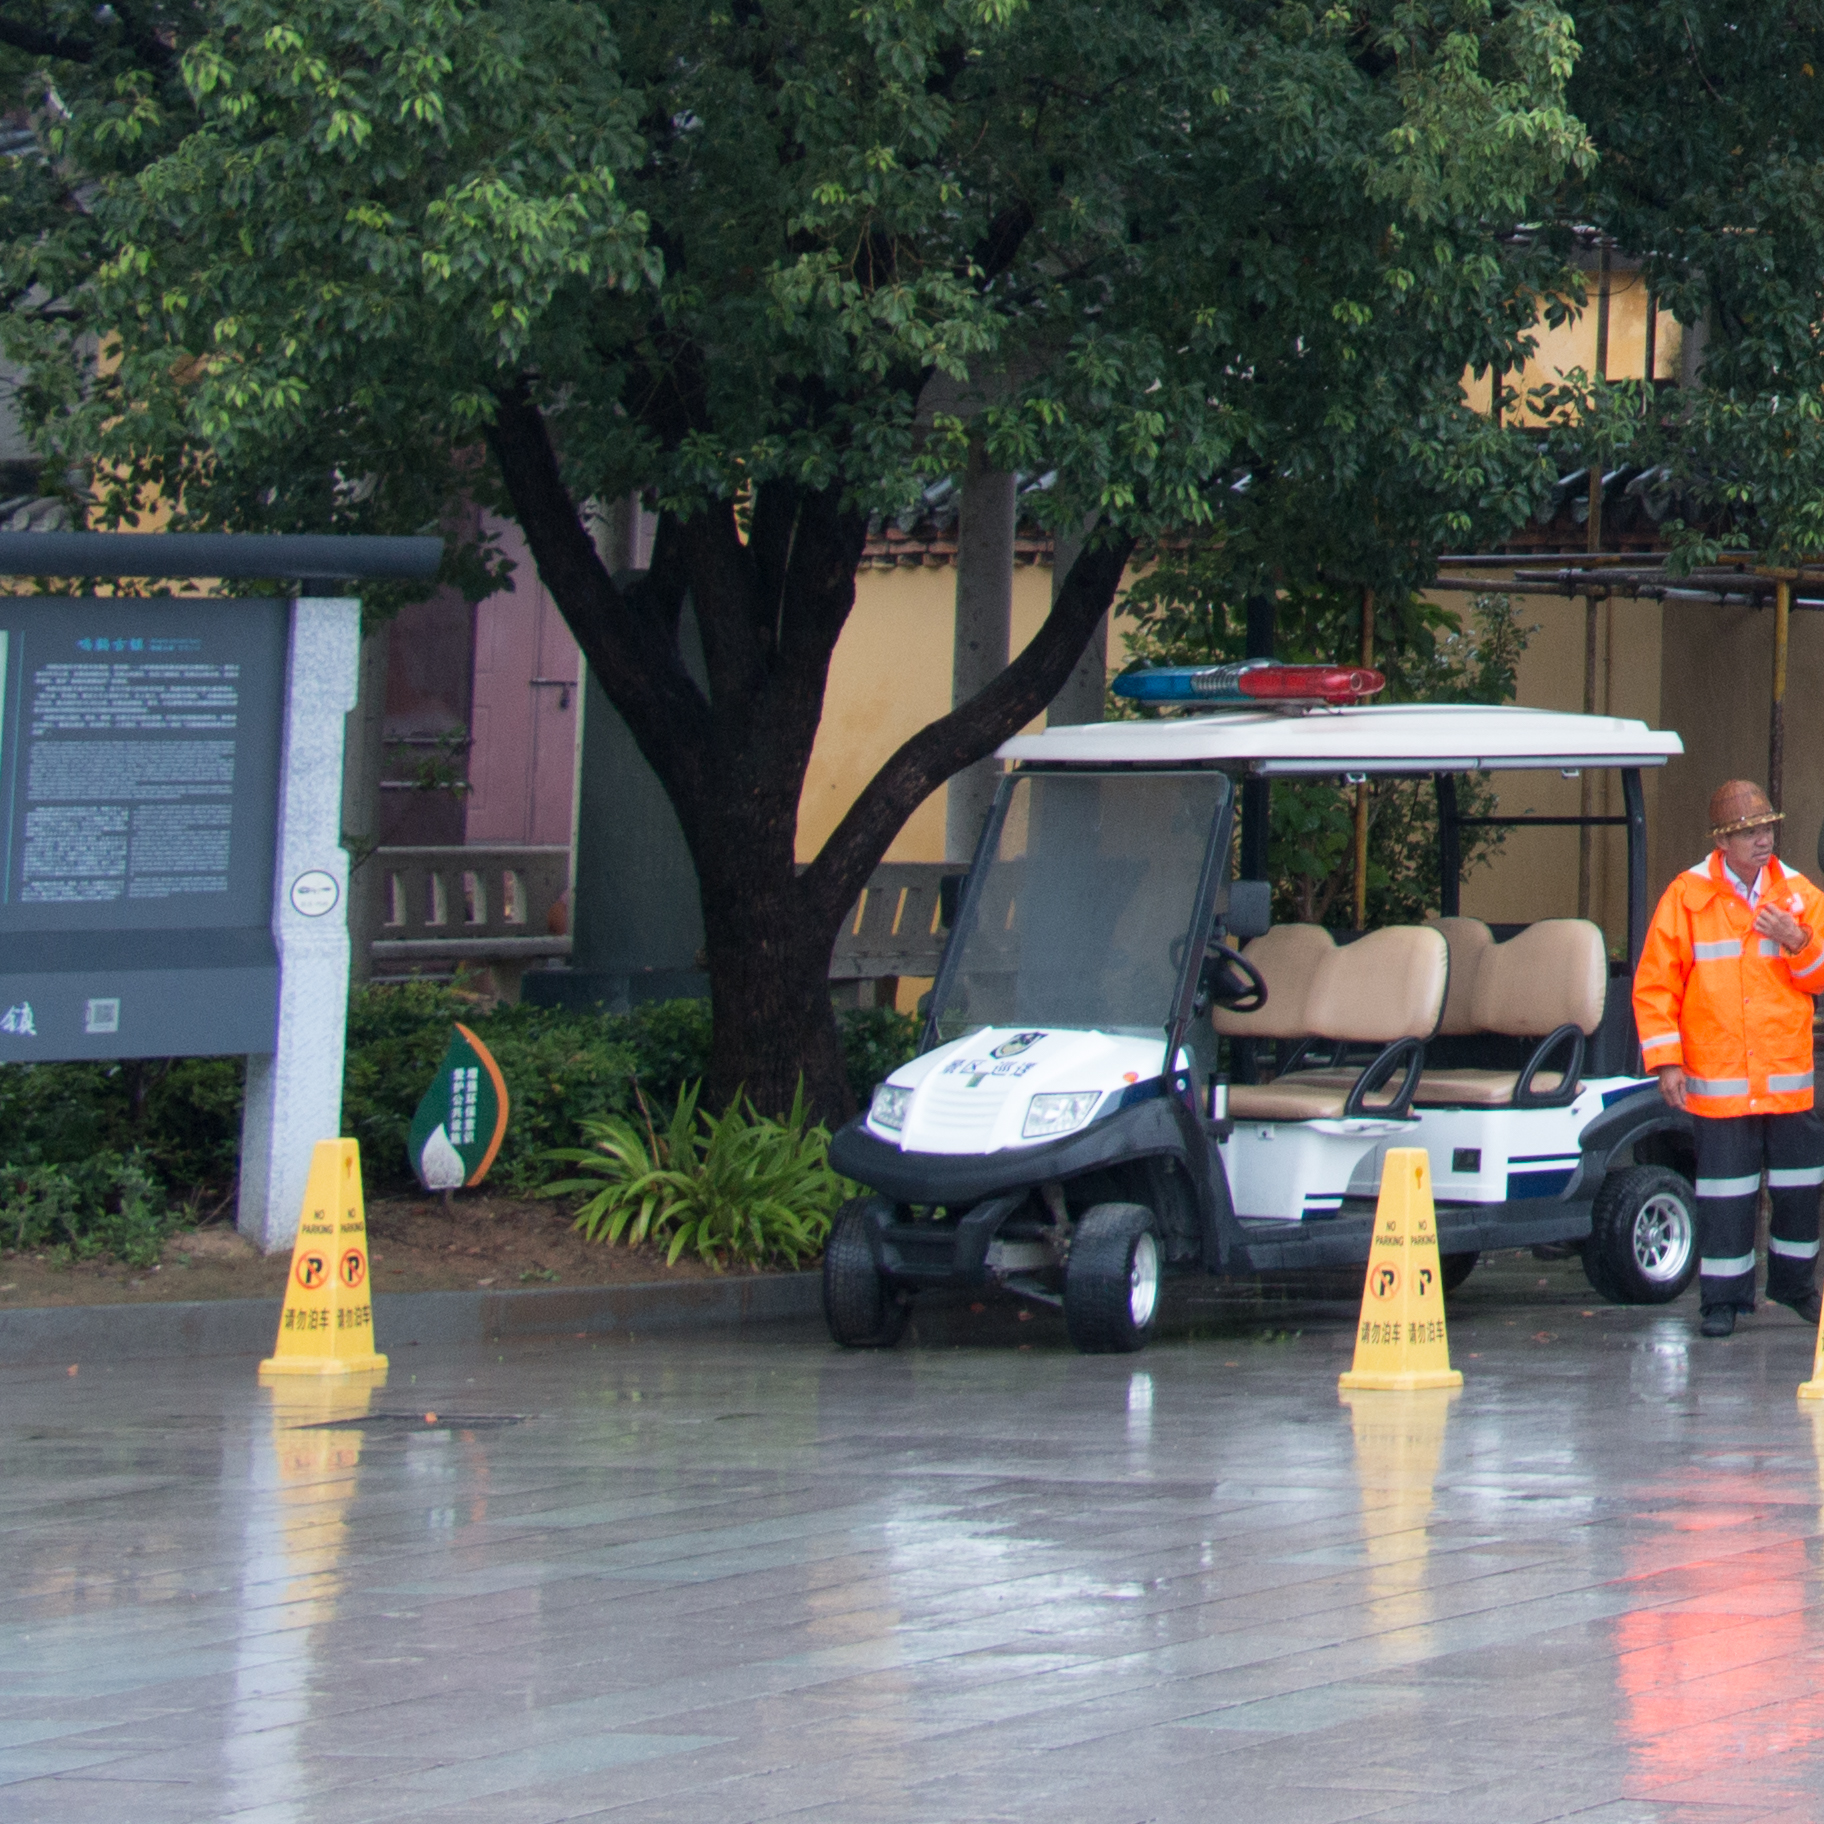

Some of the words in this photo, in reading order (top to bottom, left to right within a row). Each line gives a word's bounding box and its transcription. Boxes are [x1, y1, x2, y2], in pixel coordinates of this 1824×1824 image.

[302, 1223, 333, 1235] PARKING
[1375, 1235, 1404, 1246] PARKING
[285, 1307, 330, 1331] 请勿泊车
[1361, 1320, 1401, 1344] 请勿泊车
